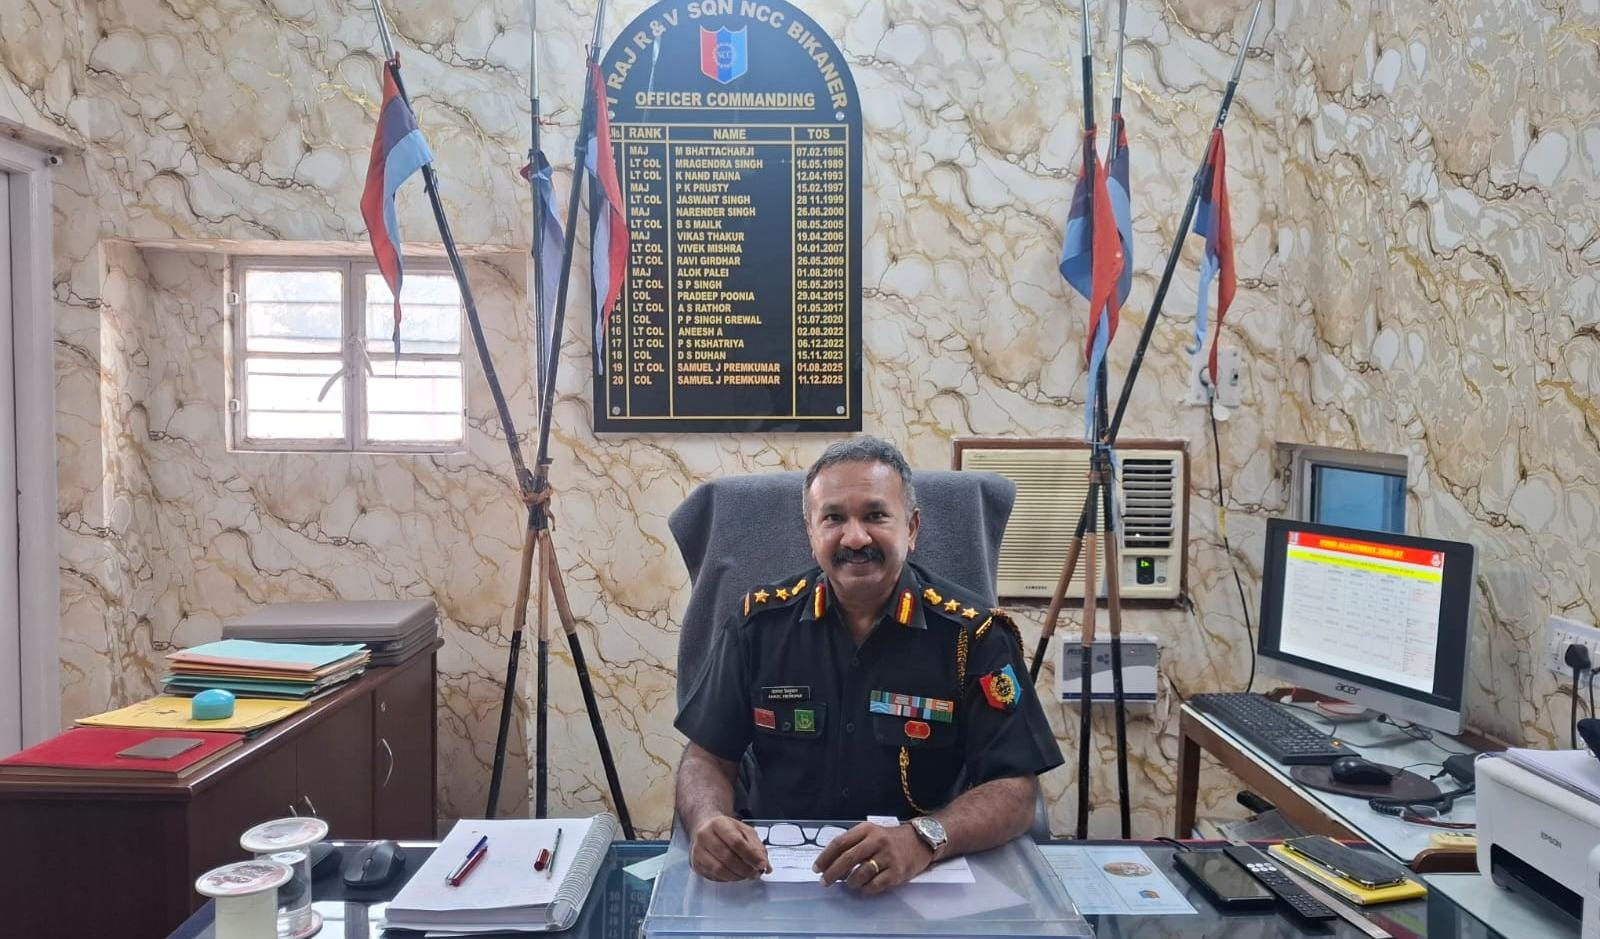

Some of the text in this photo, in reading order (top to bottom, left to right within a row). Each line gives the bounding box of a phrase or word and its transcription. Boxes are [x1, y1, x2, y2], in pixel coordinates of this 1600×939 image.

[607, 47, 638, 90] RAJ
[633, 30, 653, 51] R
[649, 19, 667, 37] &
[663, 8, 679, 27] V
[687, 0, 733, 19] SQN
[739, 0, 786, 29] NCC
[786, 20, 849, 109] BIKANER
[635, 92, 815, 107] OFFICER COMMANDING
[629, 127, 662, 139] RANK
[713, 128, 746, 140] NAME
[807, 128, 831, 140] TOS
[630, 146, 649, 155] MAJ
[676, 147, 683, 155] M
[686, 147, 754, 155] BHATTACHARJI
[630, 159, 641, 168] LT
[643, 159, 661, 168] COL
[676, 159, 732, 168] MRAGENDRA
[735, 159, 763, 168] SINGH
[630, 171, 844, 180] LT COL K NAND RAINA 12.04.1993
[631, 183, 844, 192] MAJ P K PRUSTY 15.02.1997
[631, 195, 641, 204] LT
[644, 195, 662, 204] COL
[677, 195, 719, 204] JASWANT
[722, 195, 750, 204] SINGH
[631, 207, 649, 216] MAJ
[676, 207, 725, 216] NARENDER
[728, 207, 755, 216] SINGH
[631, 220, 844, 229] LT COL B S MAILK 08.05.2005
[632, 231, 844, 241] MAJ VIKAS THAKUR 19.04.2006
[632, 243, 844, 253] LT COL VIVEK MISHRA 04.01.2007
[632, 256, 844, 265] LT COL RAVI GIRDHAR 26.05.2009
[633, 268, 844, 277] MAJ ALOK PALEI 01.08.2010
[633, 279, 844, 289] LT COL S P SINGH 05.05.2013
[633, 291, 844, 301] COL PRADEEP POONIA 29.04.2015
[633, 303, 643, 312] LT
[646, 303, 664, 312] COL
[678, 304, 684, 312] A
[687, 304, 693, 312] S
[695, 304, 731, 312] RATHOR
[797, 303, 844, 312] 01.05.2017
[611, 315, 844, 325] 15 COL P P SINGH GREWAL 13.07.2020
[611, 327, 844, 336] 16 LT COL ANEESH A 02.08.2022
[612, 339, 844, 349] 17 LT COL P S KSHATRIYA 06.12.2022
[612, 350, 844, 360] 18 COL D S DUHAN 15.11.2023
[612, 363, 844, 373] 19 LT COL SAMUEL J PREMKUMAR 01.08.2025
[612, 375, 844, 385] 20 COL SAMUEL J PREMKUMAR 11.12.2025
[1335, 682, 1361, 696] acer
[1540, 831, 1563, 849] EPSON
